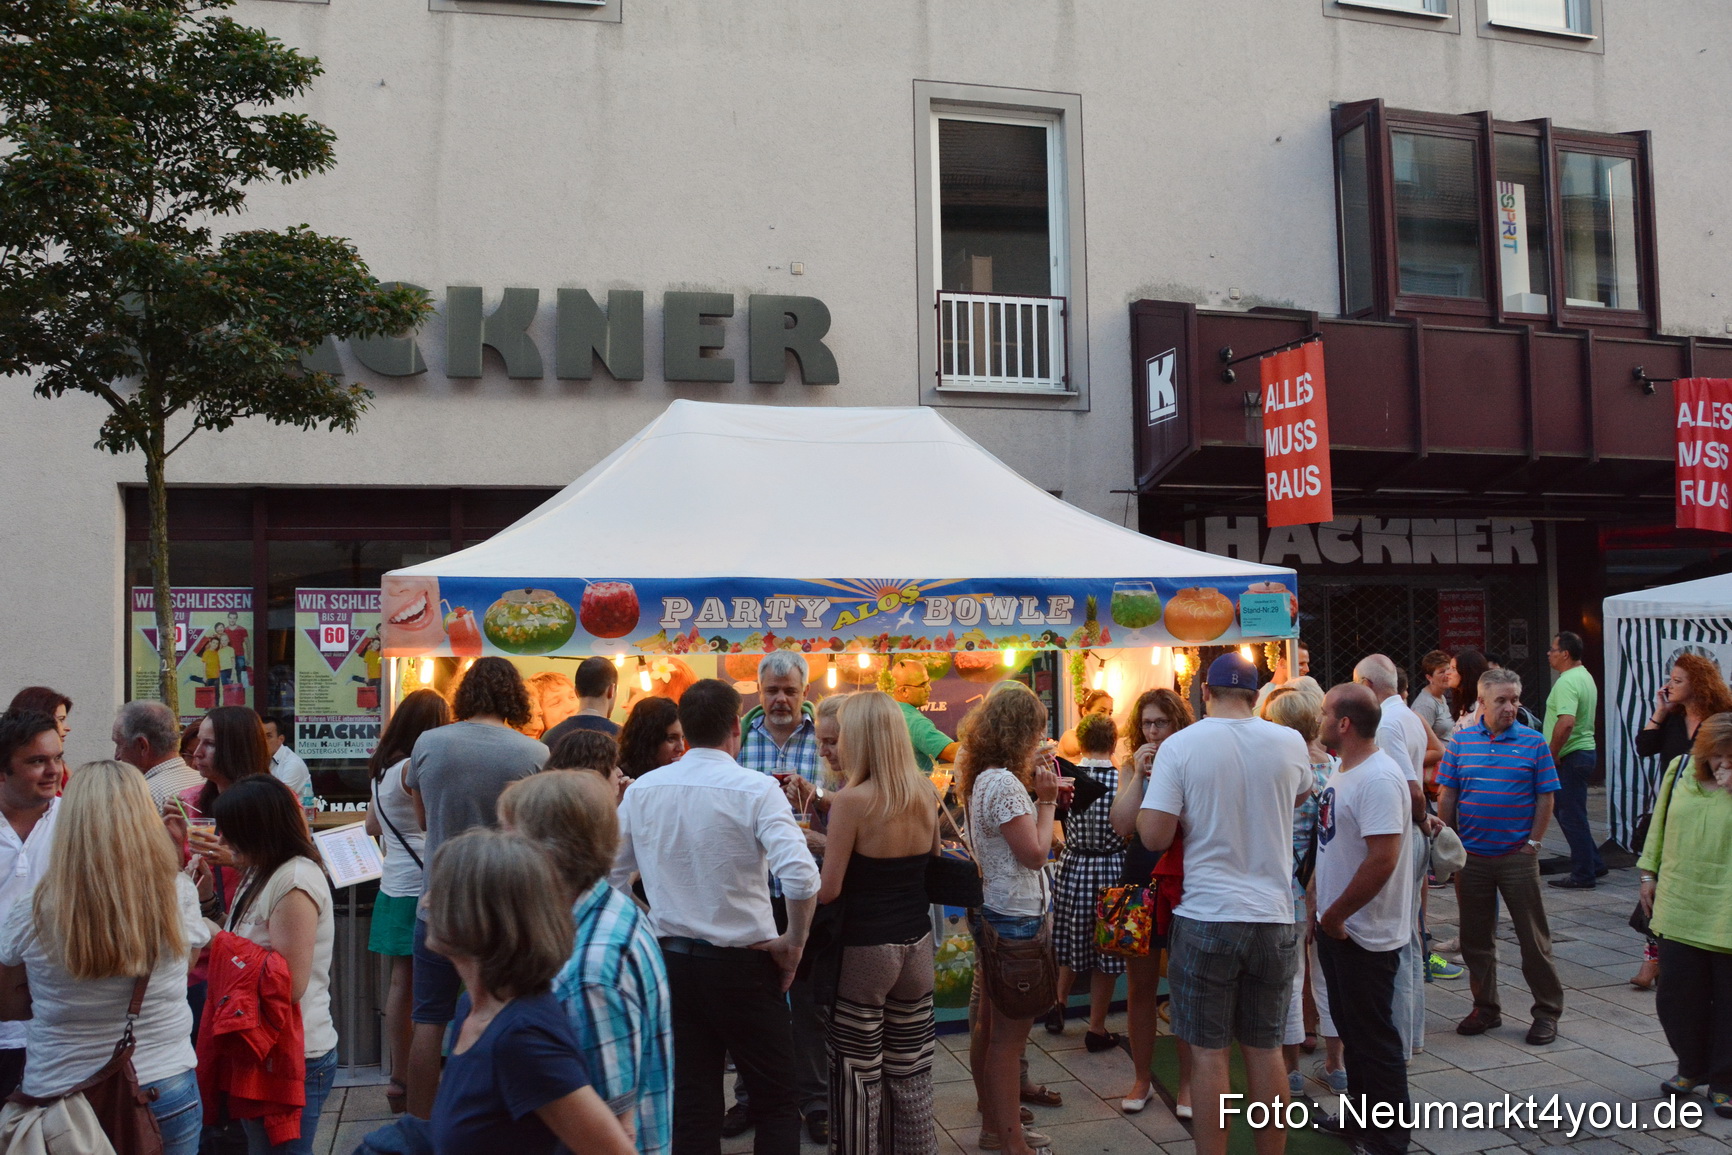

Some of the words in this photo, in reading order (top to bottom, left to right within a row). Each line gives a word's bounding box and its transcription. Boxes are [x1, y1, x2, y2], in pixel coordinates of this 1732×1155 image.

[1500, 182, 1518, 254] ESPRIT
[1148, 353, 1176, 412] K
[1264, 372, 1315, 414] ALLES
[1265, 418, 1318, 458] MUSS
[1267, 464, 1322, 501] RAUS
[1205, 515, 1538, 565] HACKNER
[135, 593, 155, 609] WI
[298, 594, 326, 610] WIR
[661, 595, 831, 629] PARTY
[831, 584, 920, 631] ALOS
[922, 595, 1075, 628] BOWLE
[174, 611, 185, 621] ZU
[321, 612, 335, 621] BIS
[336, 612, 347, 621] ZU
[175, 626, 183, 643] 0
[188, 629, 198, 640] %
[324, 626, 345, 644] 60
[350, 629, 360, 641] %
[1231, 674, 1239, 684] B
